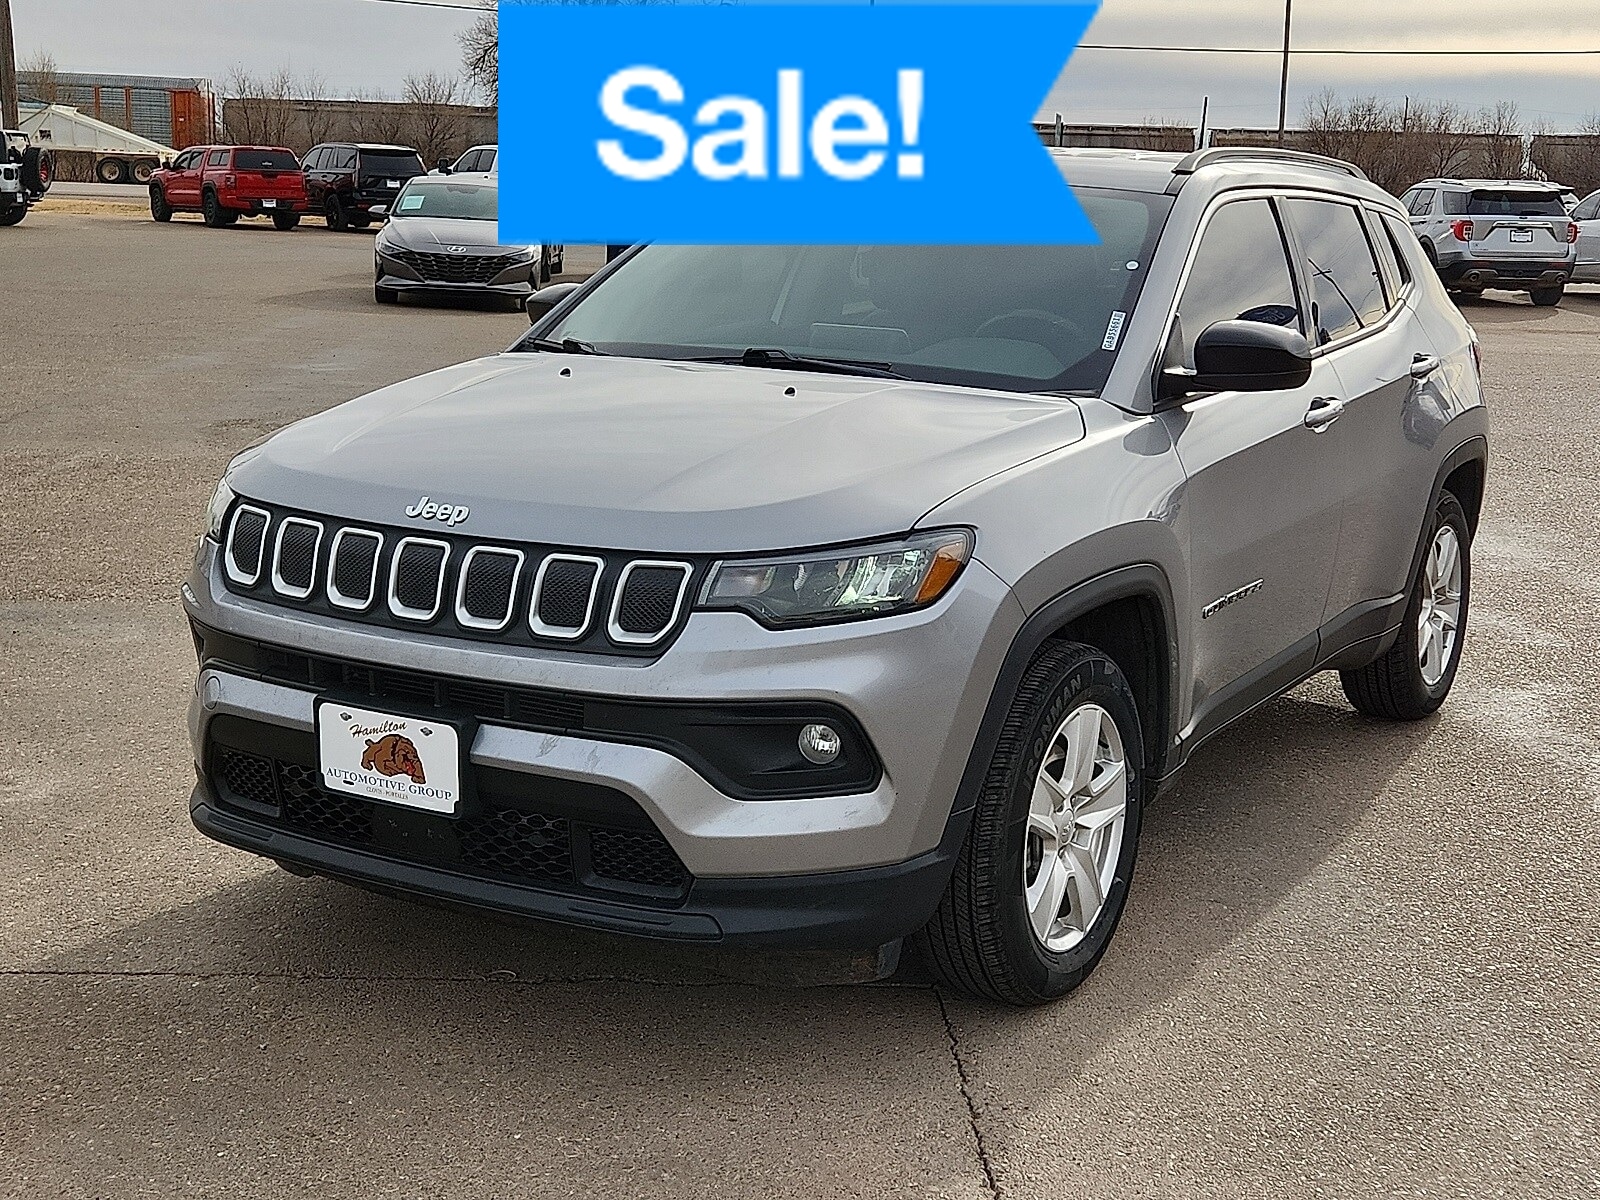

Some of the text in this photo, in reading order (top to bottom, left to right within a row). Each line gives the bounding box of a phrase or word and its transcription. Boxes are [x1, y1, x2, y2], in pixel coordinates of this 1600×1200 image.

[405, 496, 470, 527] Jeep
[349, 720, 408, 738] Hamilton
[326, 767, 453, 801] AUTOMOTIVE GROUP
